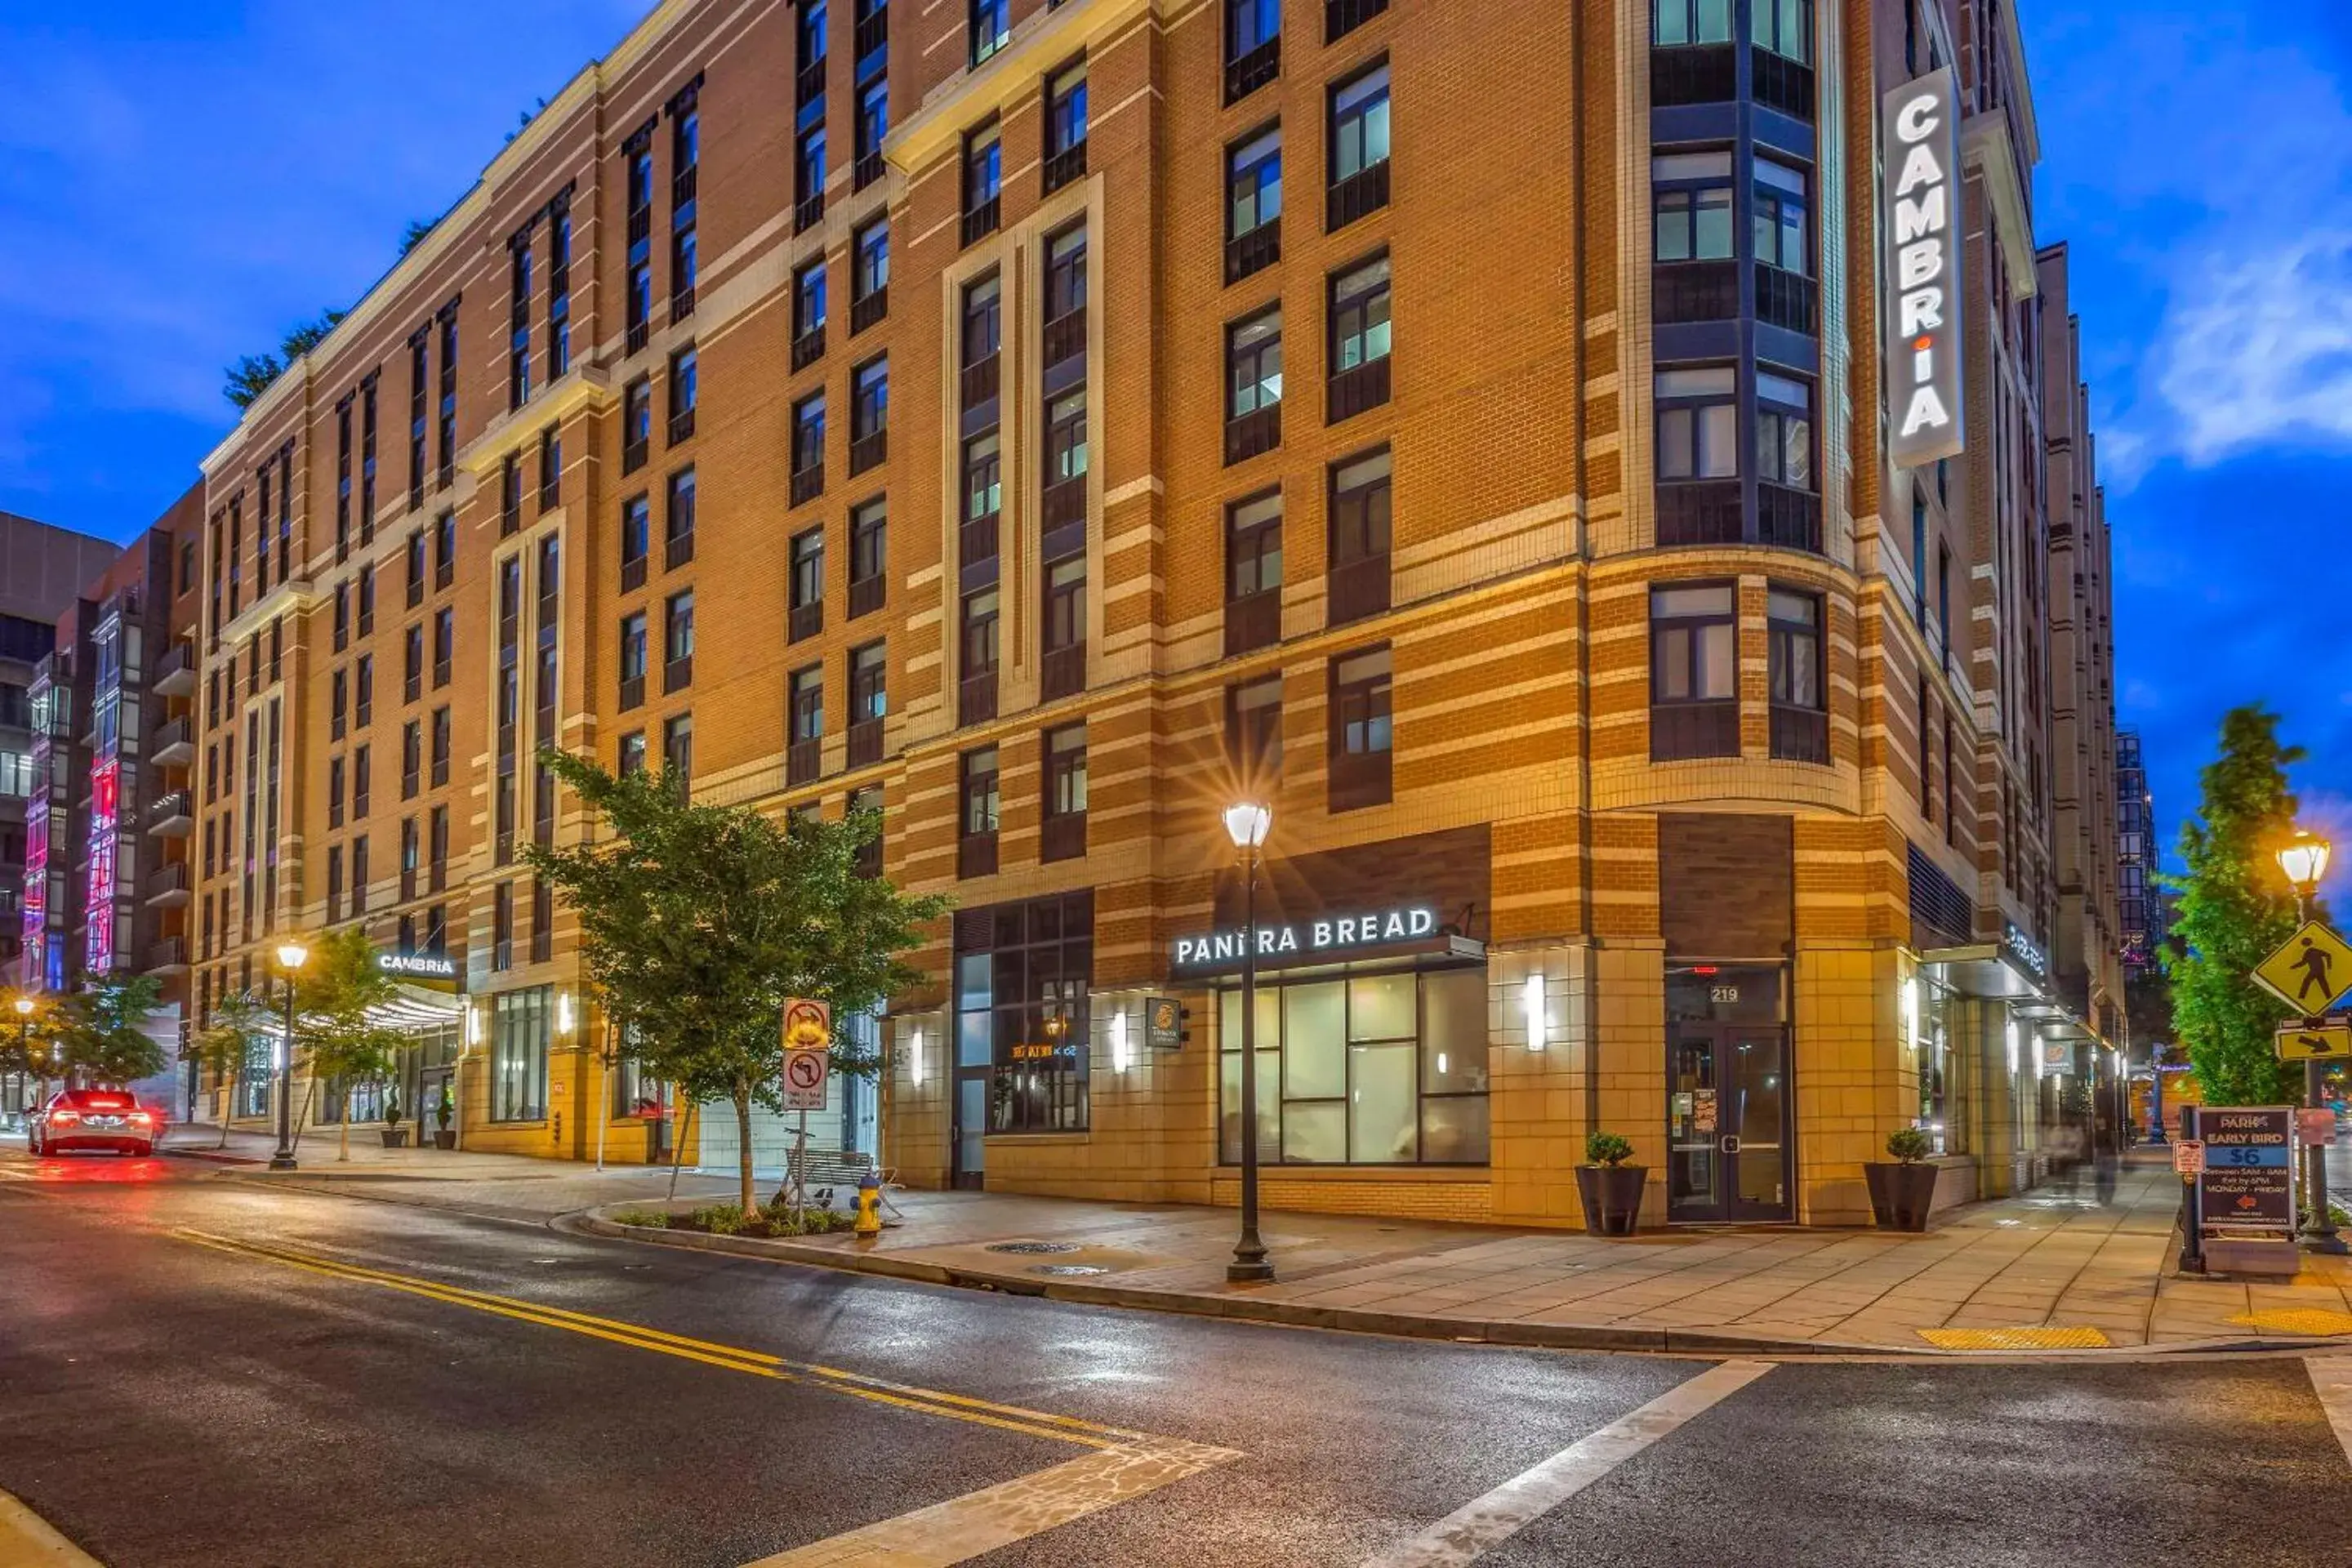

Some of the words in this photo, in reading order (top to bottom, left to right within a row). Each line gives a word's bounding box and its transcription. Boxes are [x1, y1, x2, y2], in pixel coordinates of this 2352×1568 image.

[1313, 909, 1432, 947] BREAD
[1712, 987, 1738, 1003] 219
[2207, 1133, 2248, 1143] EARLY
[2252, 1133, 2283, 1144] BIRD
[2230, 1148, 2261, 1165] $6
